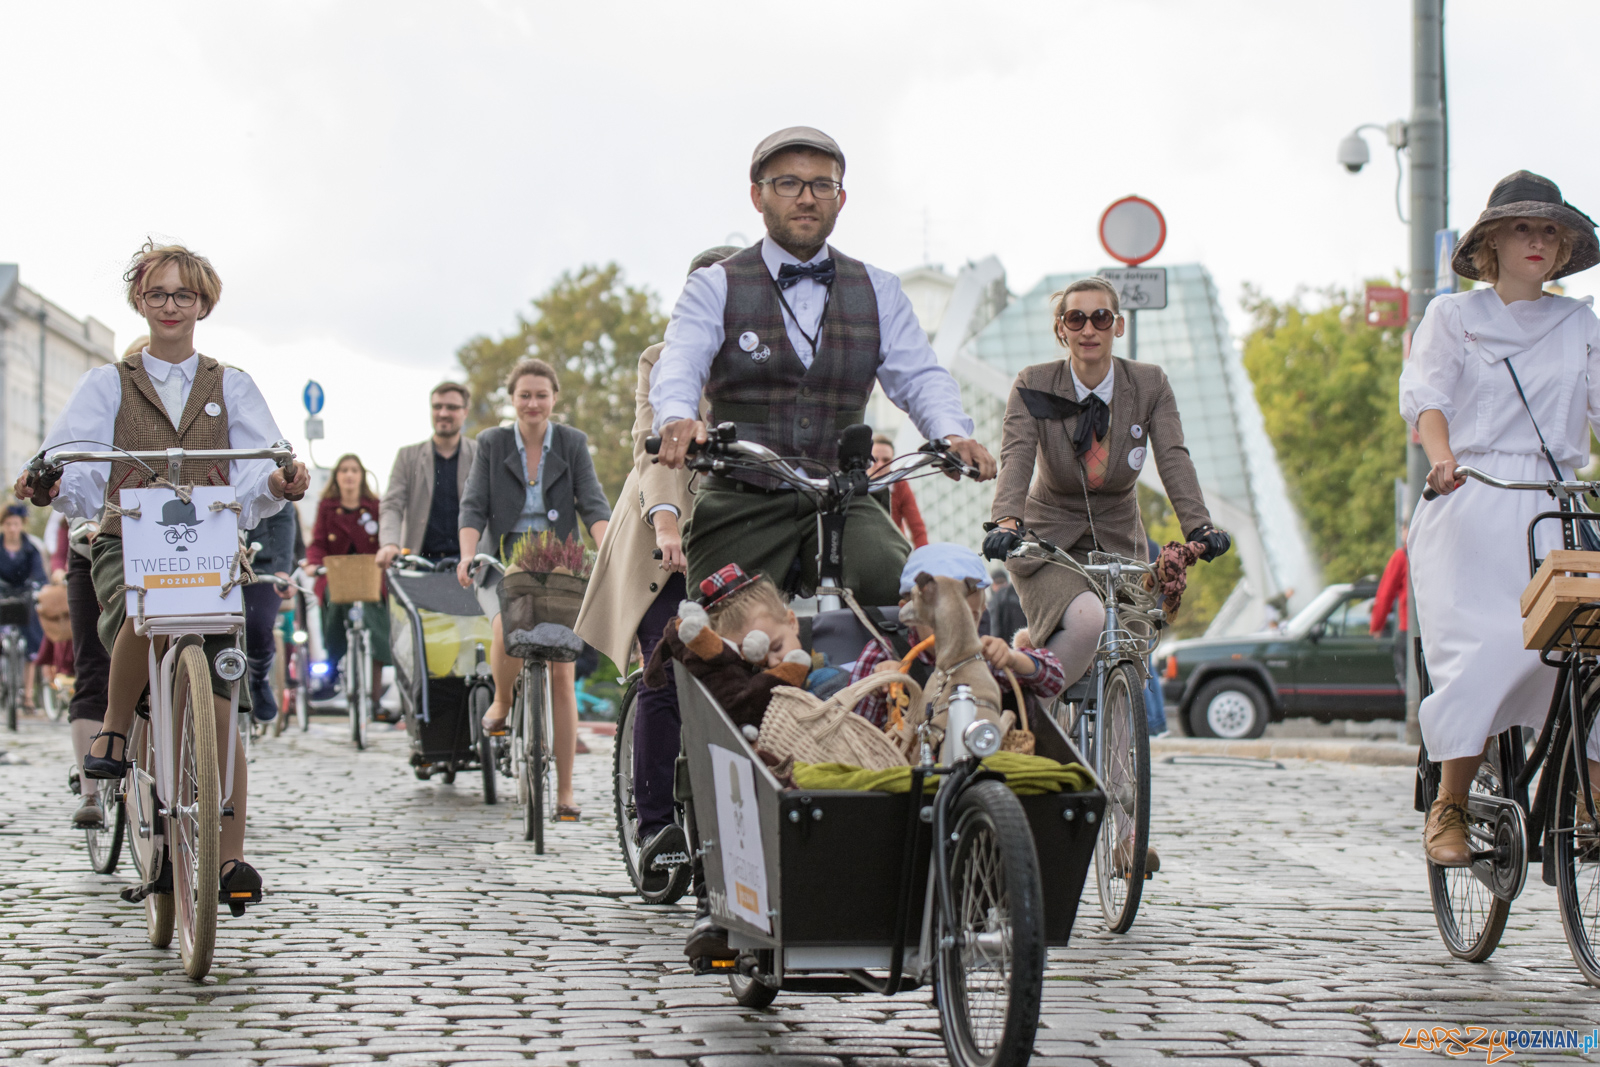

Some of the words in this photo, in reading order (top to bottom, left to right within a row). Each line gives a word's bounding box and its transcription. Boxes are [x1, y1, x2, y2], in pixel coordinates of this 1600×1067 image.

[1134, 449, 1143, 468] 9
[131, 557, 190, 573] TWEED
[197, 555, 234, 570] RIDE
[160, 575, 205, 585] POZNAŃ
